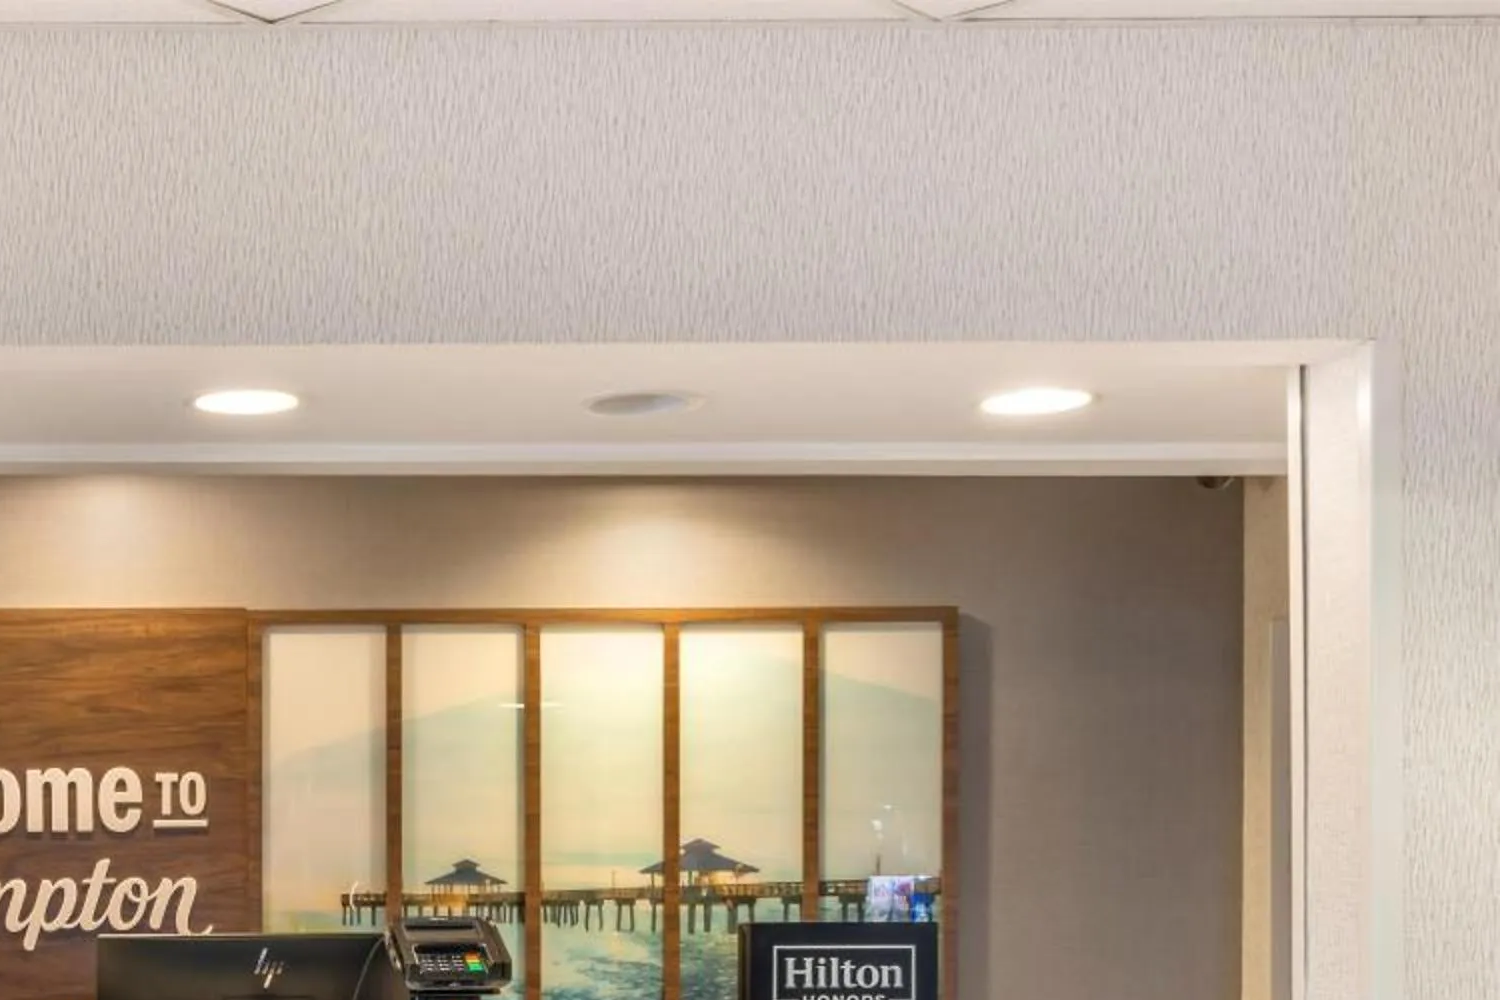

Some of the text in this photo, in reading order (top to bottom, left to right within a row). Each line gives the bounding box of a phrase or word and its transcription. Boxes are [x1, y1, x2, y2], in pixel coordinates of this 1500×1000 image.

[154, 771, 207, 816] TO
[254, 947, 284, 989] hp
[784, 956, 904, 988] Hilton
